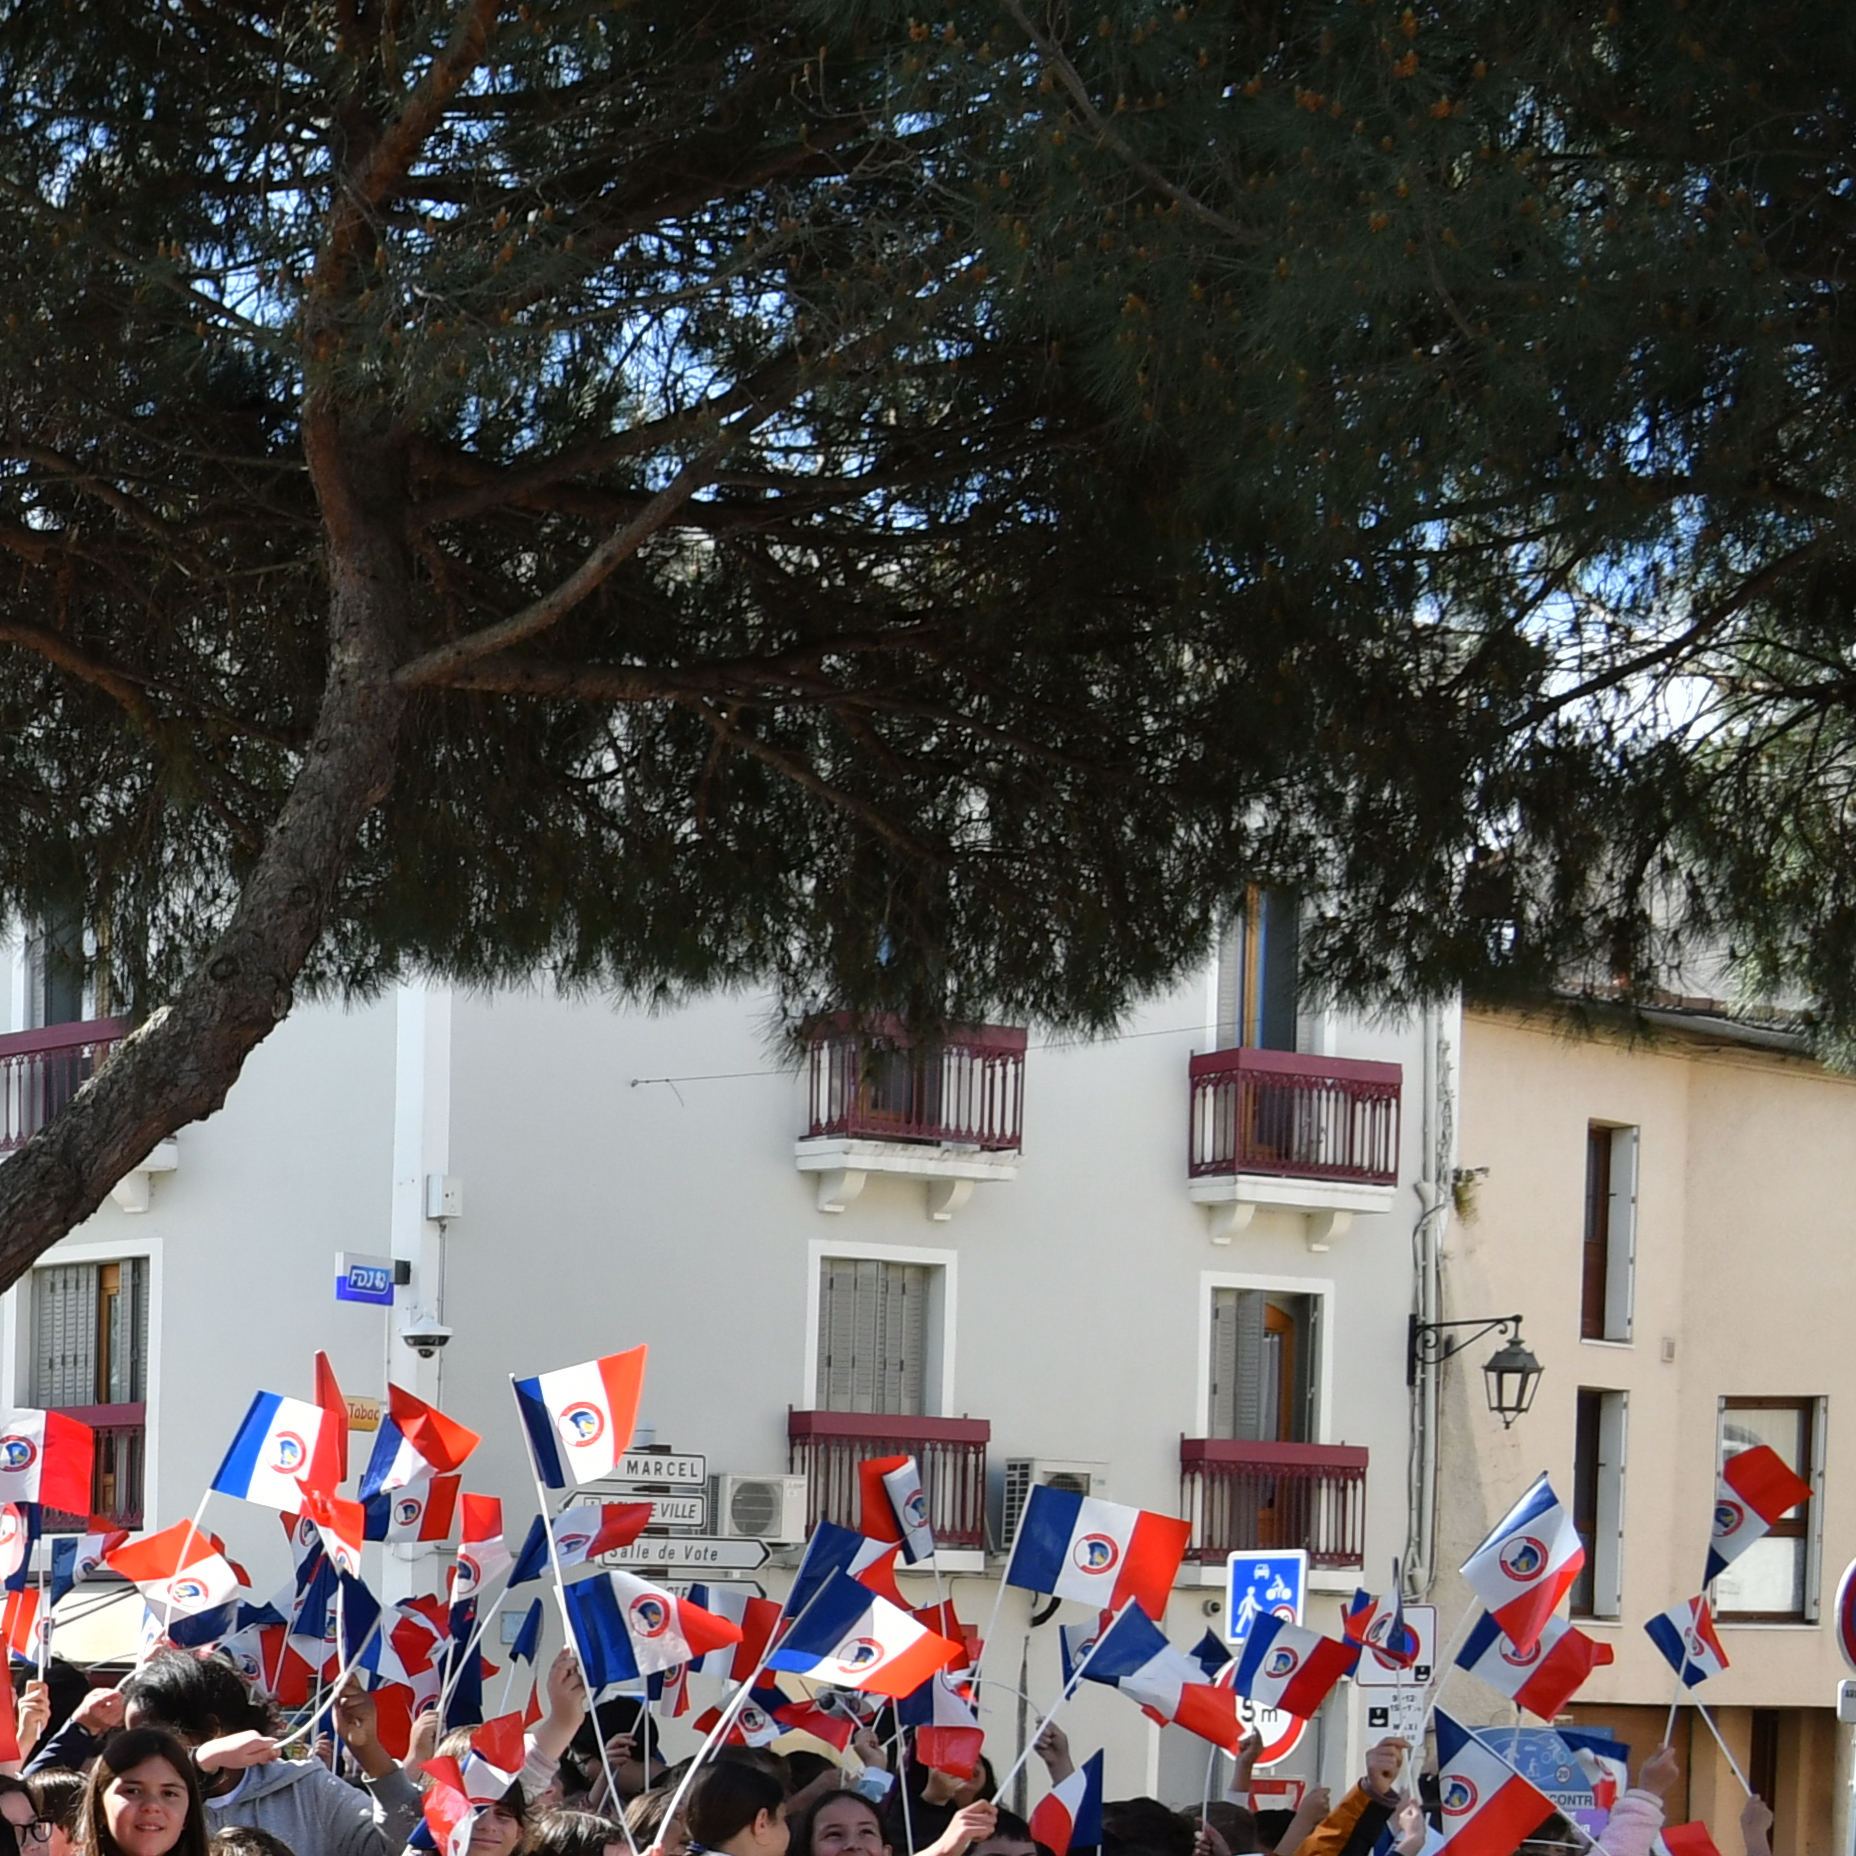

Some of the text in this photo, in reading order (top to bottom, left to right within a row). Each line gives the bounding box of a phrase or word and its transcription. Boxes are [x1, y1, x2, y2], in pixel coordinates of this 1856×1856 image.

[350, 1269, 374, 1288] FDJ
[347, 1402, 379, 1421] Tabac
[626, 1460, 698, 1478] MARCEL
[660, 1503, 697, 1519] VILLE
[658, 1545, 675, 1560] de
[684, 1546, 718, 1562] Vote
[1261, 1707, 1278, 1723] m
[1558, 1770, 1568, 1779] 20
